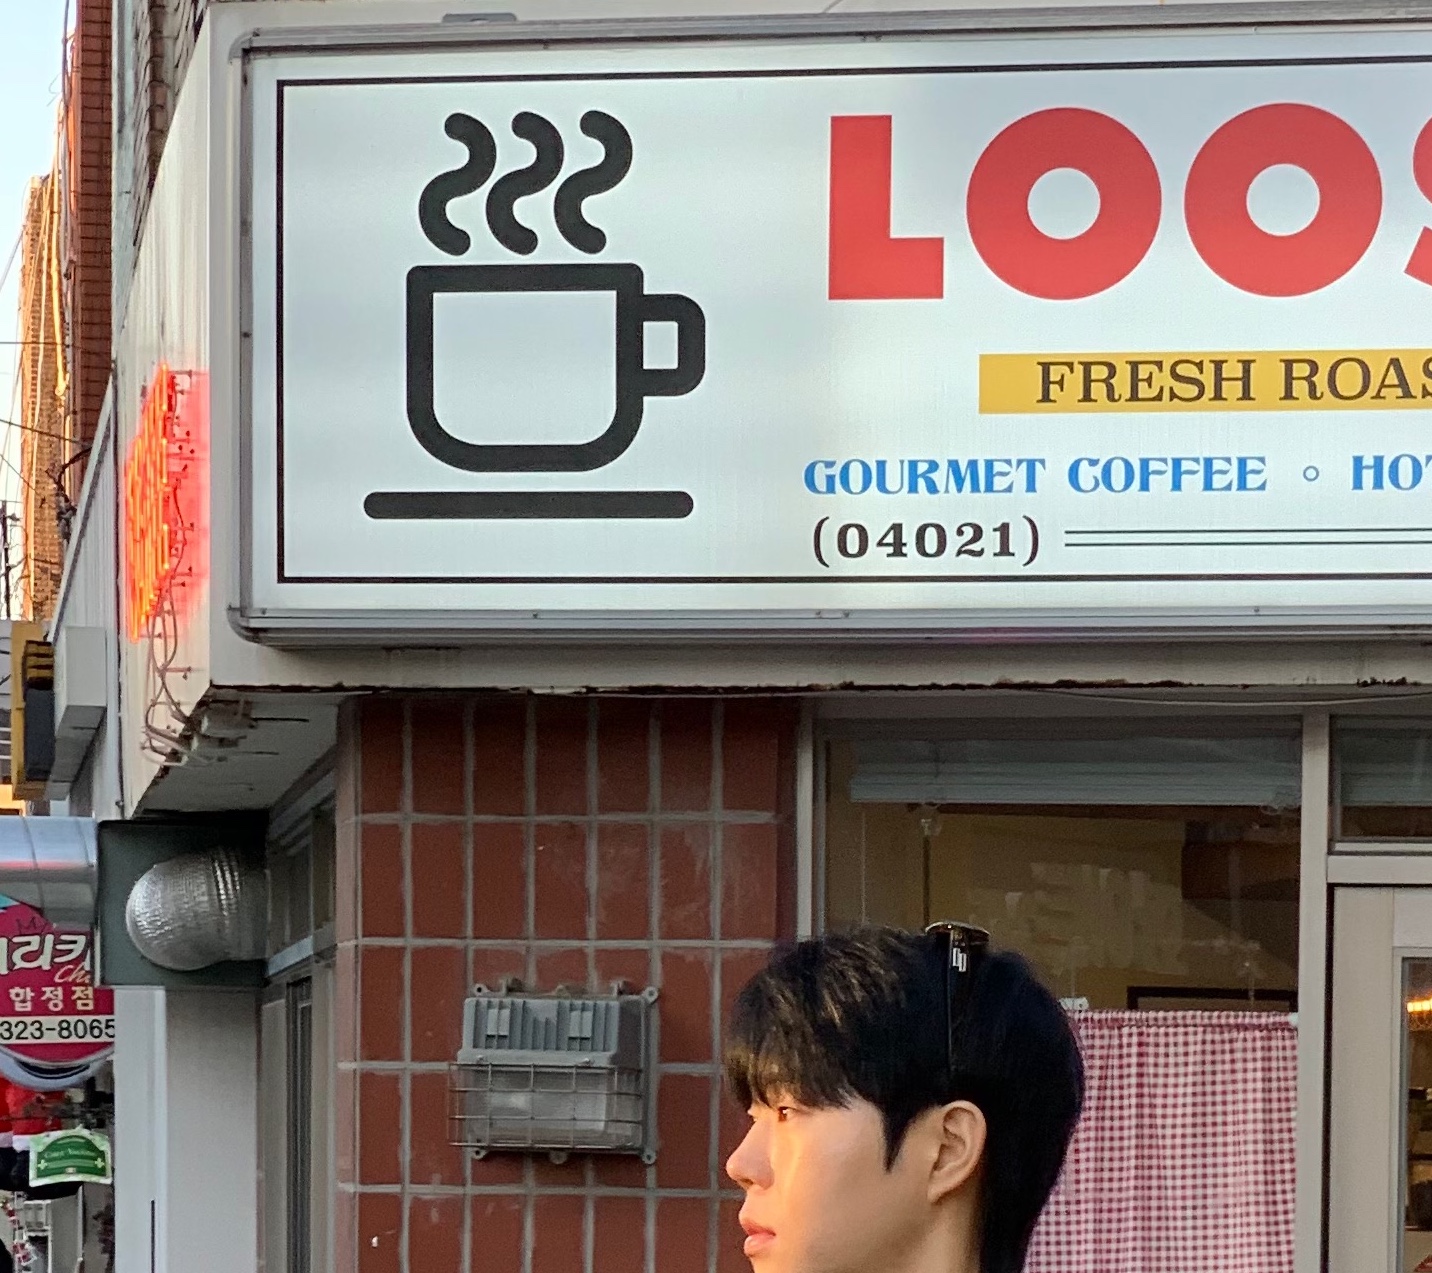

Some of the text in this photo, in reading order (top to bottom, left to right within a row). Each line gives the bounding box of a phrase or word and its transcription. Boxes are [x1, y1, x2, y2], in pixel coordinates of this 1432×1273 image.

[1036, 358, 1255, 403] FRESH
[803, 458, 1046, 495] GOURMET
[1067, 455, 1267, 493] COFFEE
[811, 514, 1041, 568] (04021)
[9, 986, 95, 1012] 합정점
